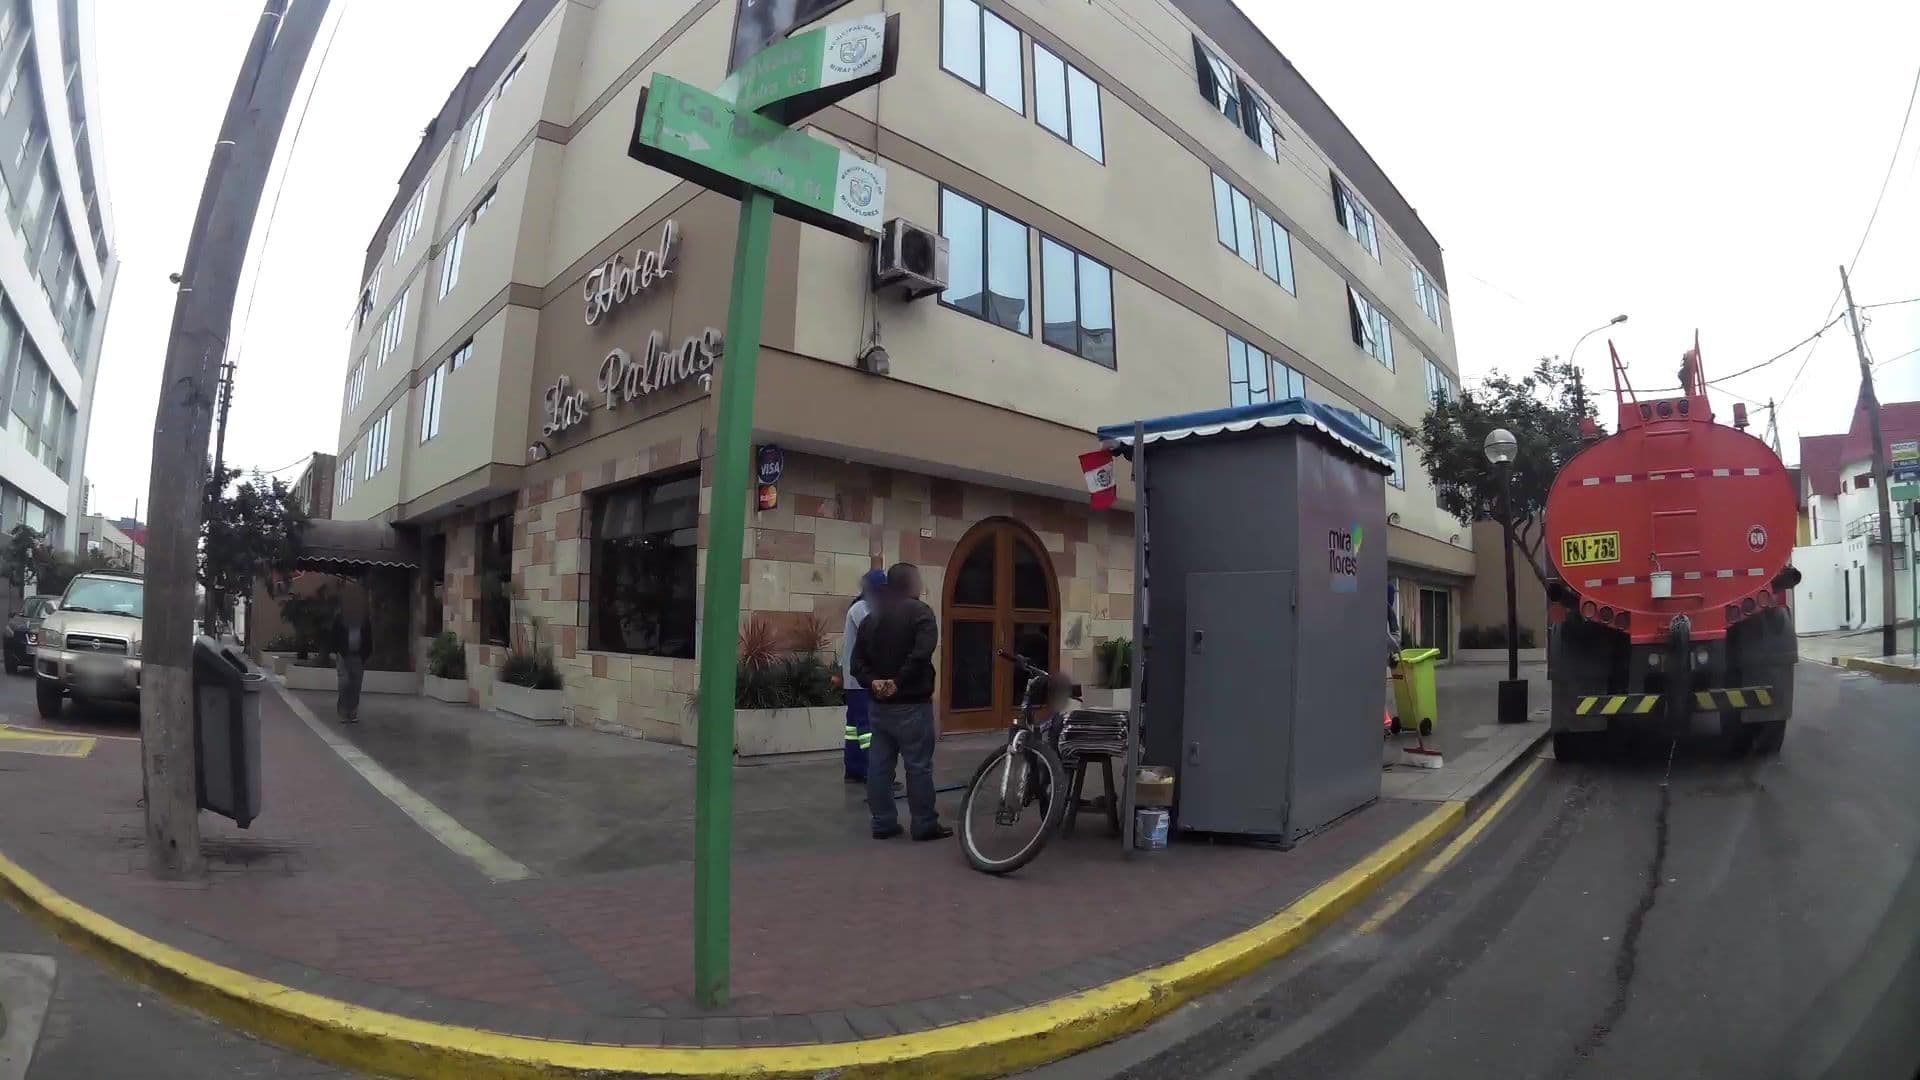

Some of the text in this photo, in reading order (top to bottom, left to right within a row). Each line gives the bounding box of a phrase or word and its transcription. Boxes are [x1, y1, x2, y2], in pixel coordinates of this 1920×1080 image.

[840, 194, 880, 217] MIRAFLORES
[583, 218, 681, 325] Hotel
[543, 326, 724, 437] Las Palmas
[761, 462, 780, 476] VISA
[1328, 527, 1352, 551] mira
[1565, 537, 1616, 561] F8J-752
[1750, 532, 1764, 546] 60
[1329, 549, 1357, 576] flores
